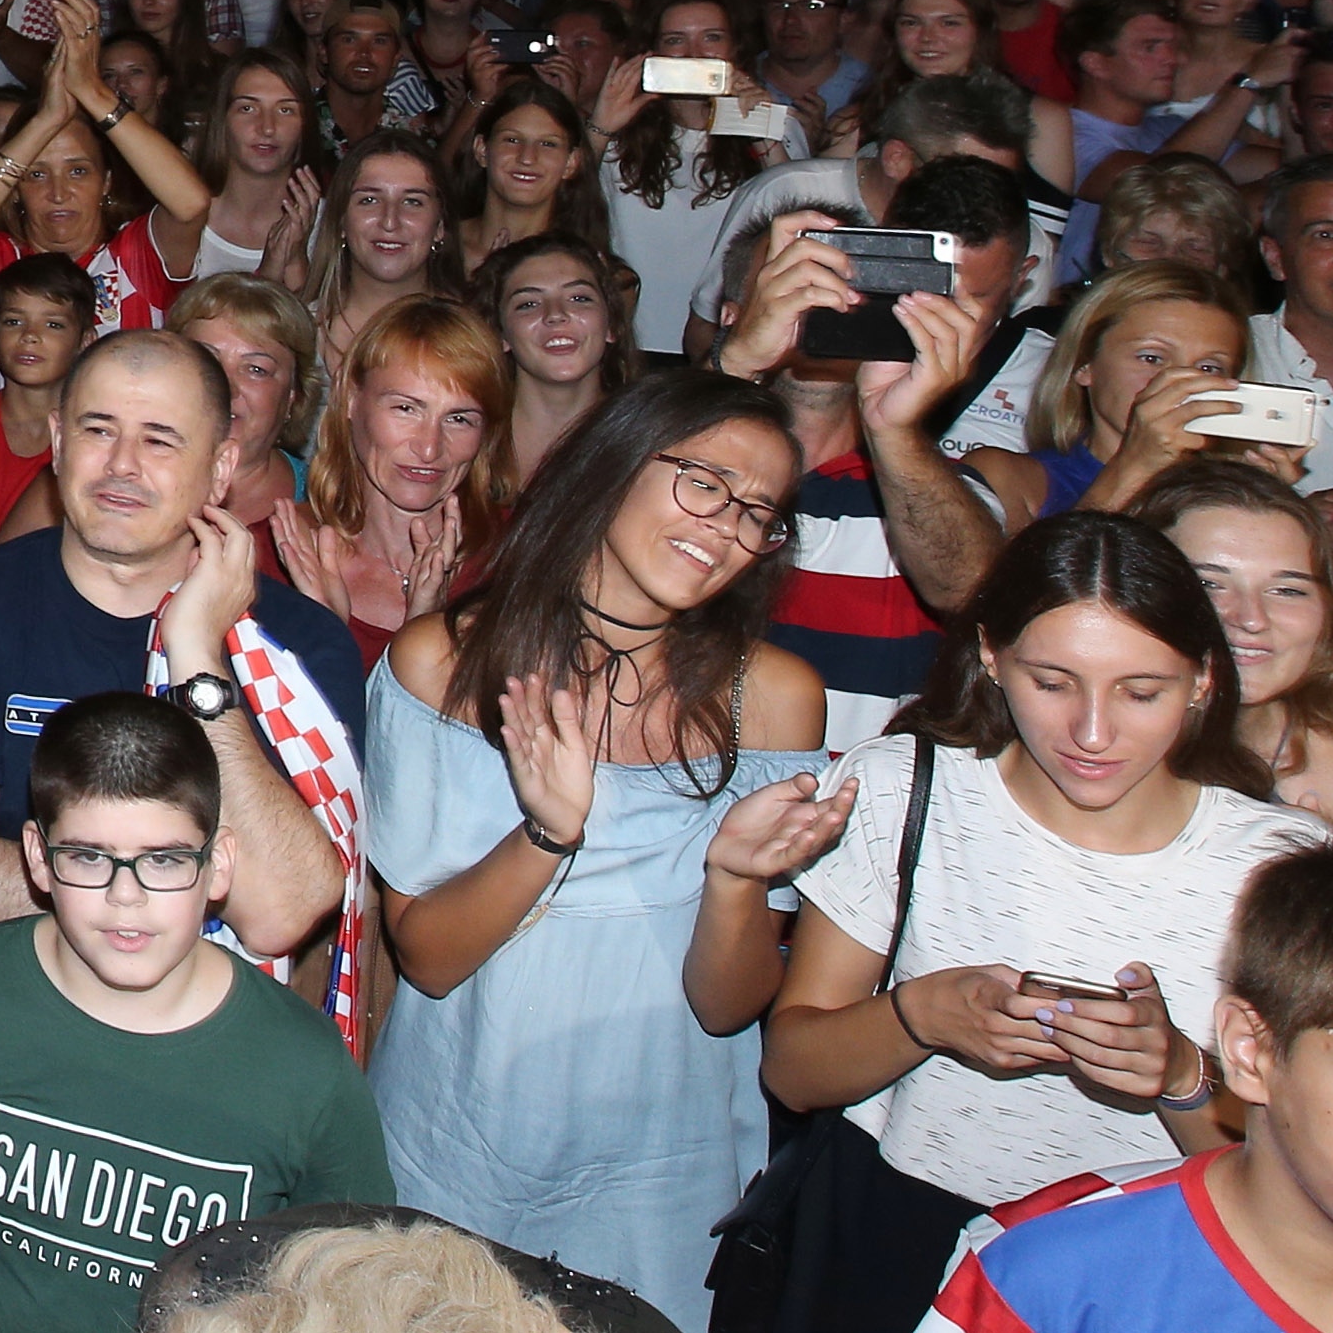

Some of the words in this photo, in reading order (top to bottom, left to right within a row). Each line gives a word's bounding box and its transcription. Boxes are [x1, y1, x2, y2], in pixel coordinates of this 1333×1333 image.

[966, 403, 1025, 425] CROATI
[81, 1159, 229, 1247] DIEGO
[1, 1229, 144, 1290] CALIFORN
